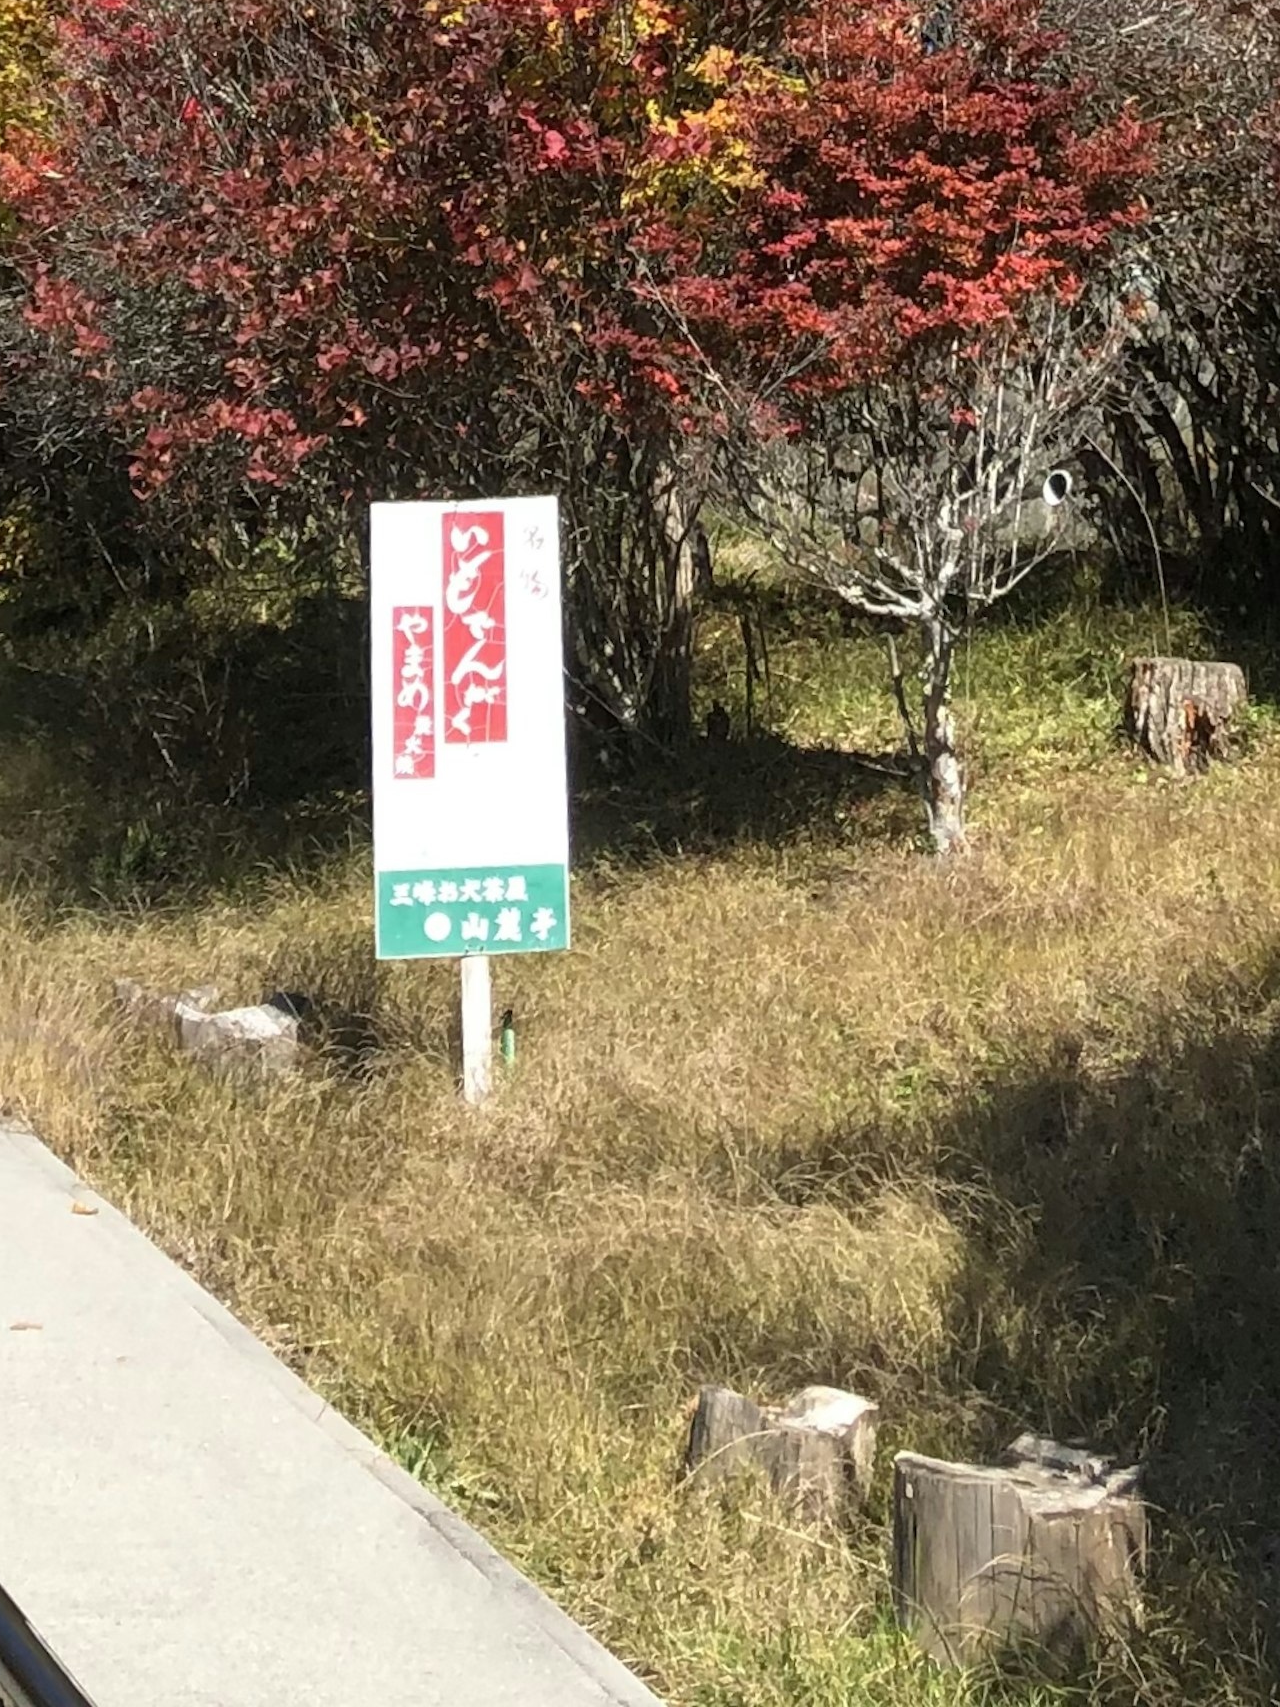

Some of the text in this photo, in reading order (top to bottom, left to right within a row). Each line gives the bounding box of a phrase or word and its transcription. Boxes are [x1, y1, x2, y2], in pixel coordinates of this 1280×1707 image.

[446, 524, 505, 736] いもでんがく
